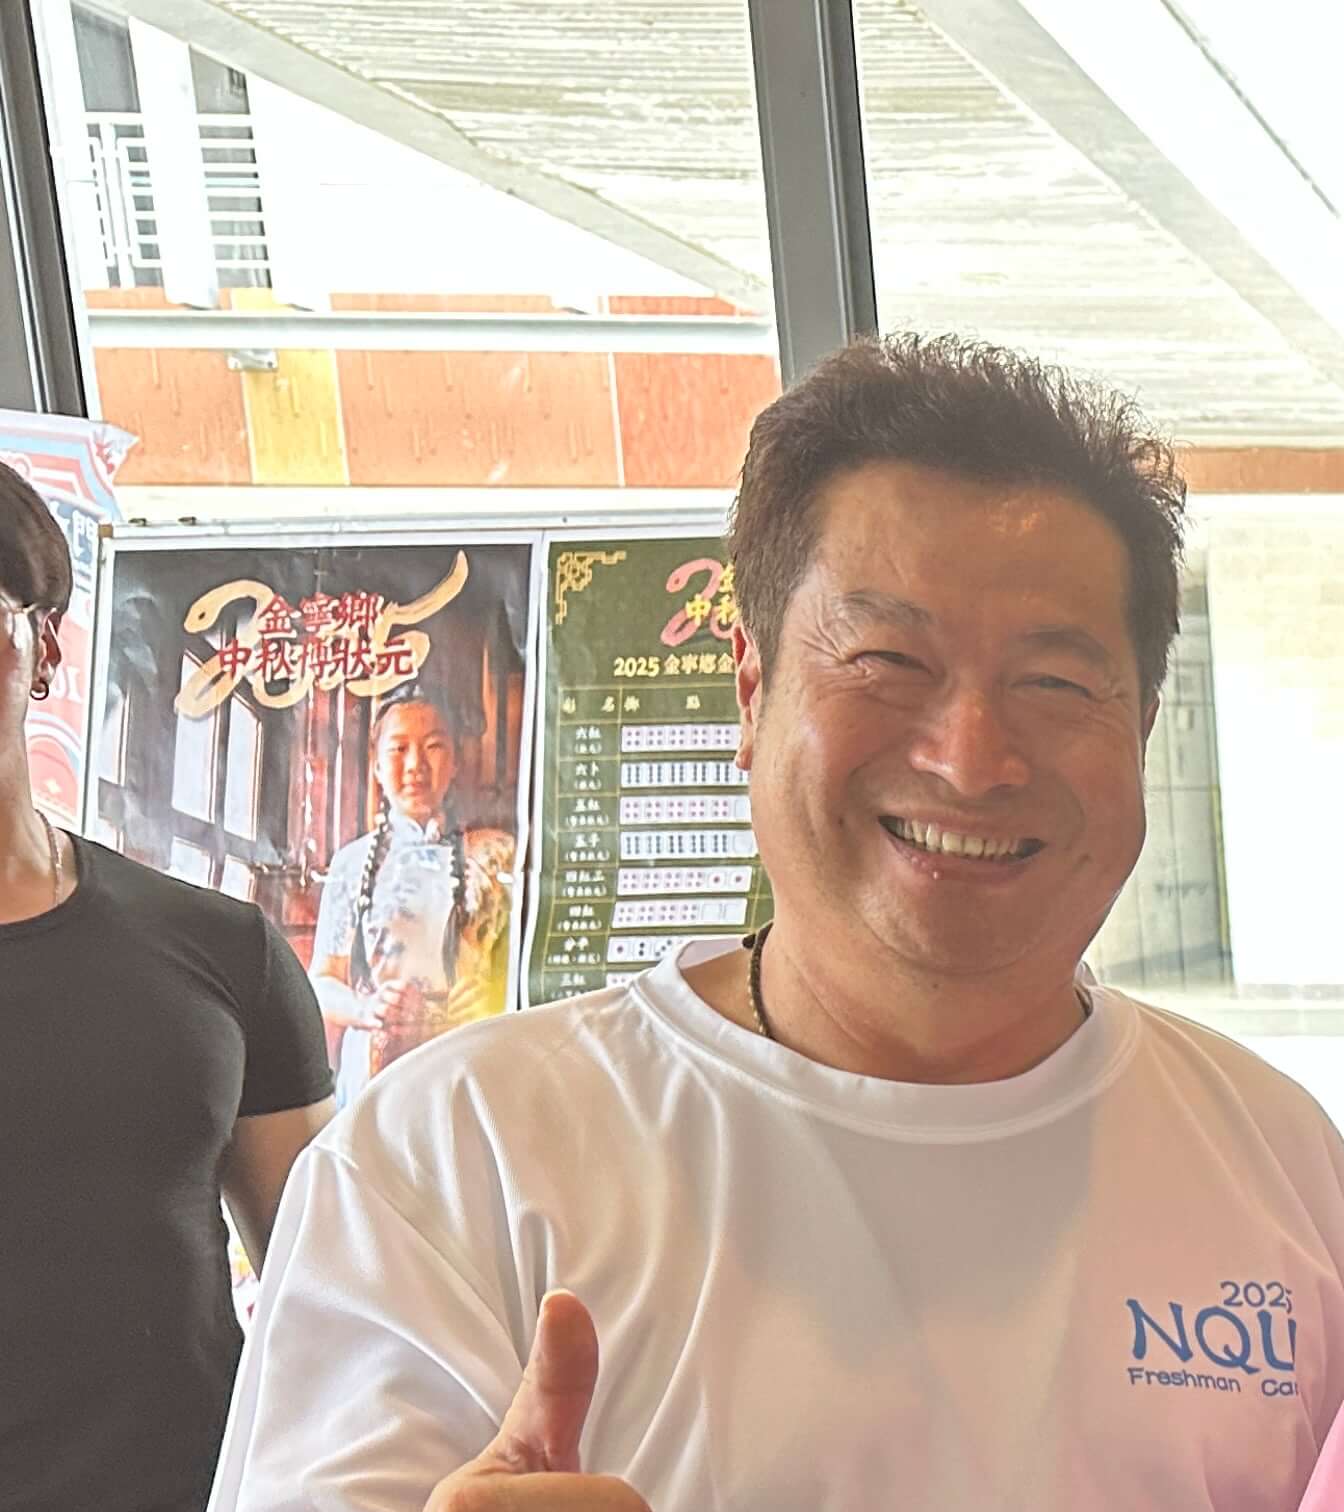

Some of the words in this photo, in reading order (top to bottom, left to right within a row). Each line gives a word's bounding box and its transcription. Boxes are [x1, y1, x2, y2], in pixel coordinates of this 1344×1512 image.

[257, 591, 386, 638] 金寧鄉
[613, 656, 660, 677] 2025
[1125, 1298, 1298, 1375] NQU
[1127, 1366, 1242, 1393] Freshman
